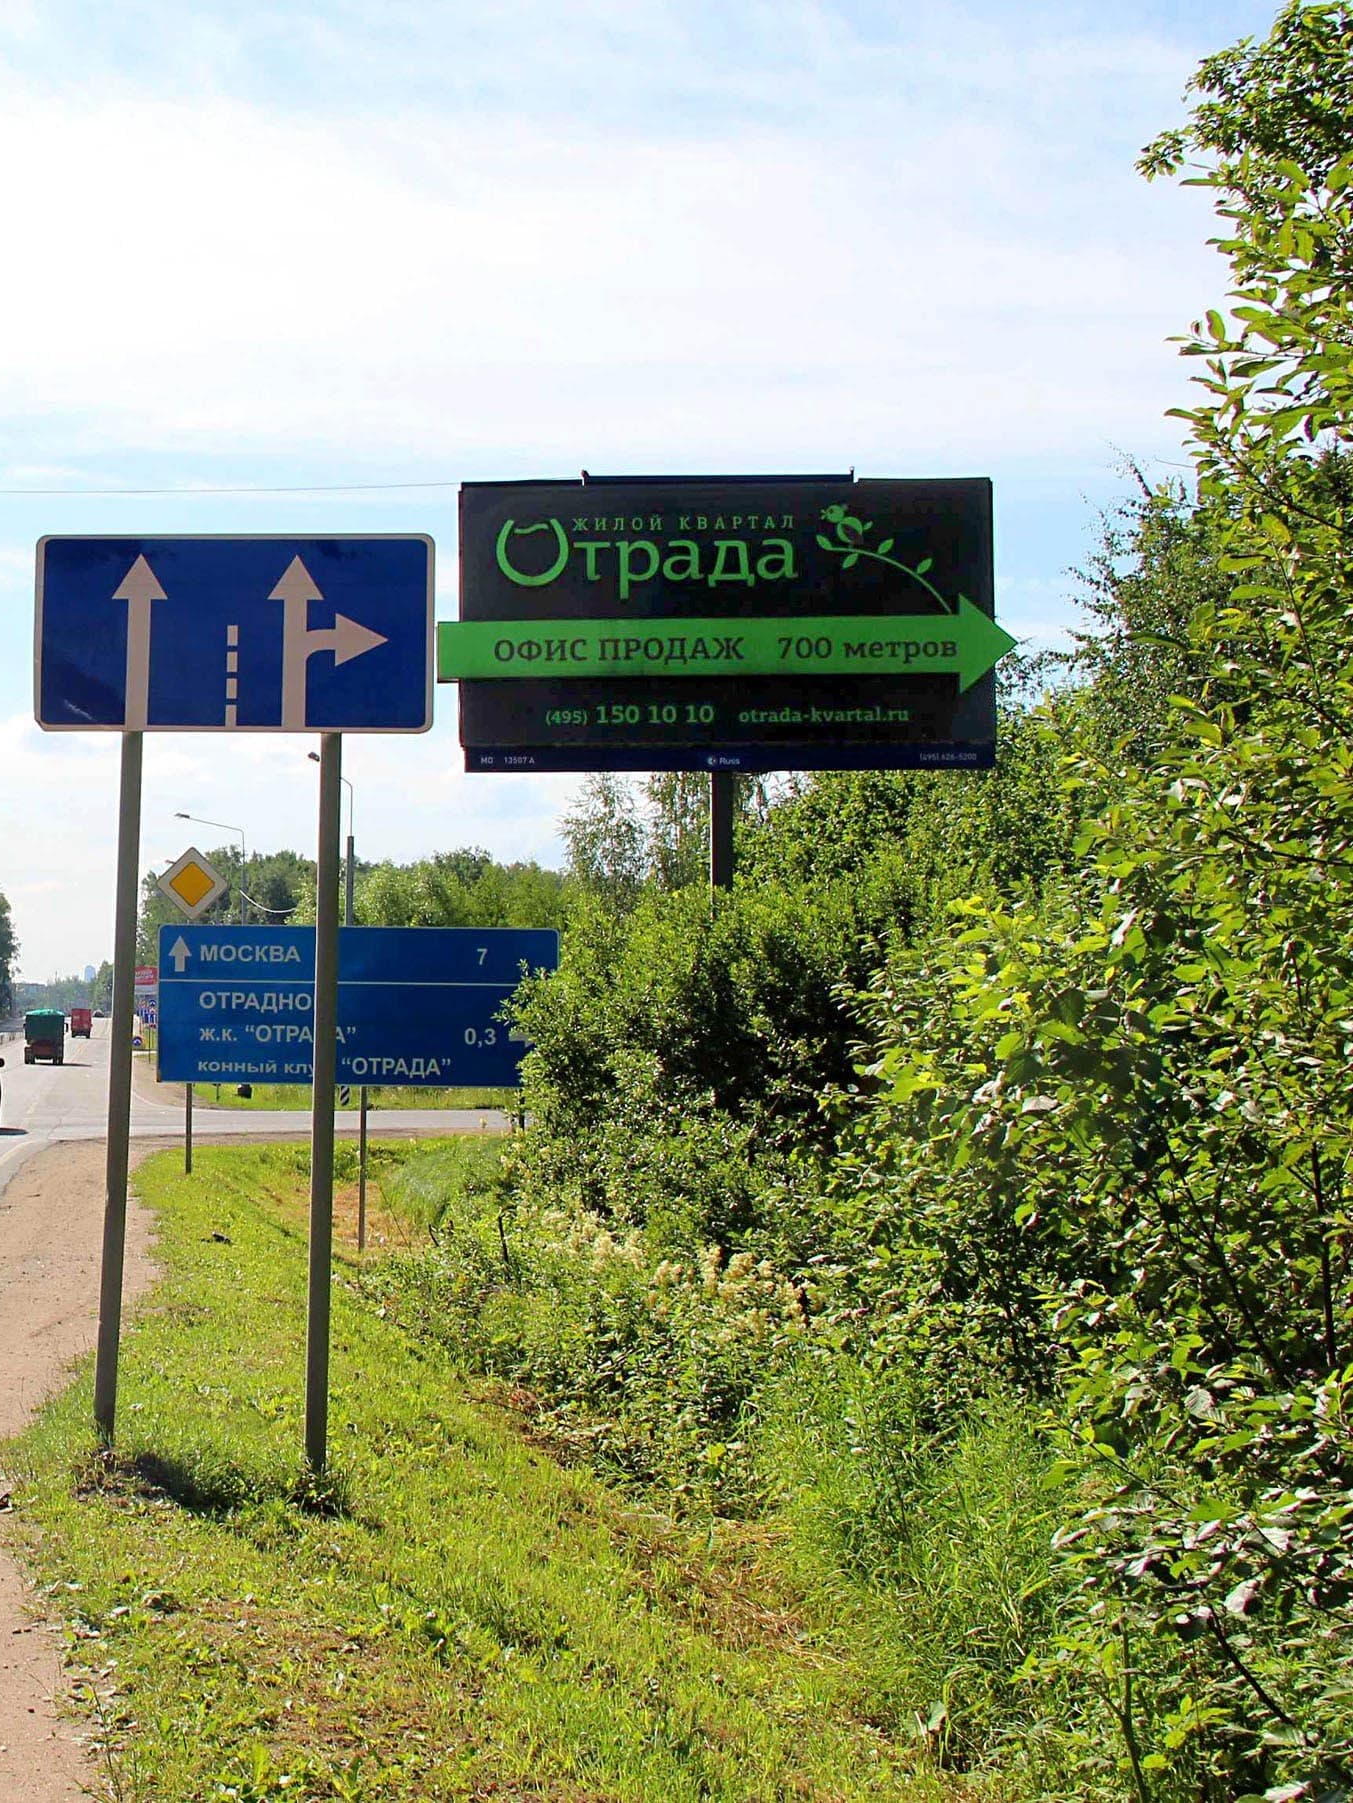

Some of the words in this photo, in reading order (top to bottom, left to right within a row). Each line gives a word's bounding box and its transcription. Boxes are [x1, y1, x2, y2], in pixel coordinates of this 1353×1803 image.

[572, 515, 663, 531] ЖИЛОЙ
[680, 514, 794, 530] КВАРТАЛ
[496, 518, 798, 599] Отрада
[493, 638, 587, 662] ОФИС
[597, 637, 745, 665] ПРОДАЖ
[777, 637, 832, 660] 700
[843, 638, 958, 664] метров
[545, 709, 588, 726] (495)
[596, 705, 640, 724] 150
[648, 705, 677, 723] 10
[685, 704, 715, 723] 10
[738, 706, 910, 723] otrada-kvartal.ru
[719, 756, 741, 765] Russ
[200, 944, 301, 963] МОСКВА
[476, 947, 488, 966] 7
[199, 991, 314, 1014] ОТРАДНО
[244, 1024, 357, 1045] “ОТРАА”
[464, 1027, 497, 1048] 0,3
[198, 1059, 278, 1074] конный
[284, 1062, 314, 1078] клу
